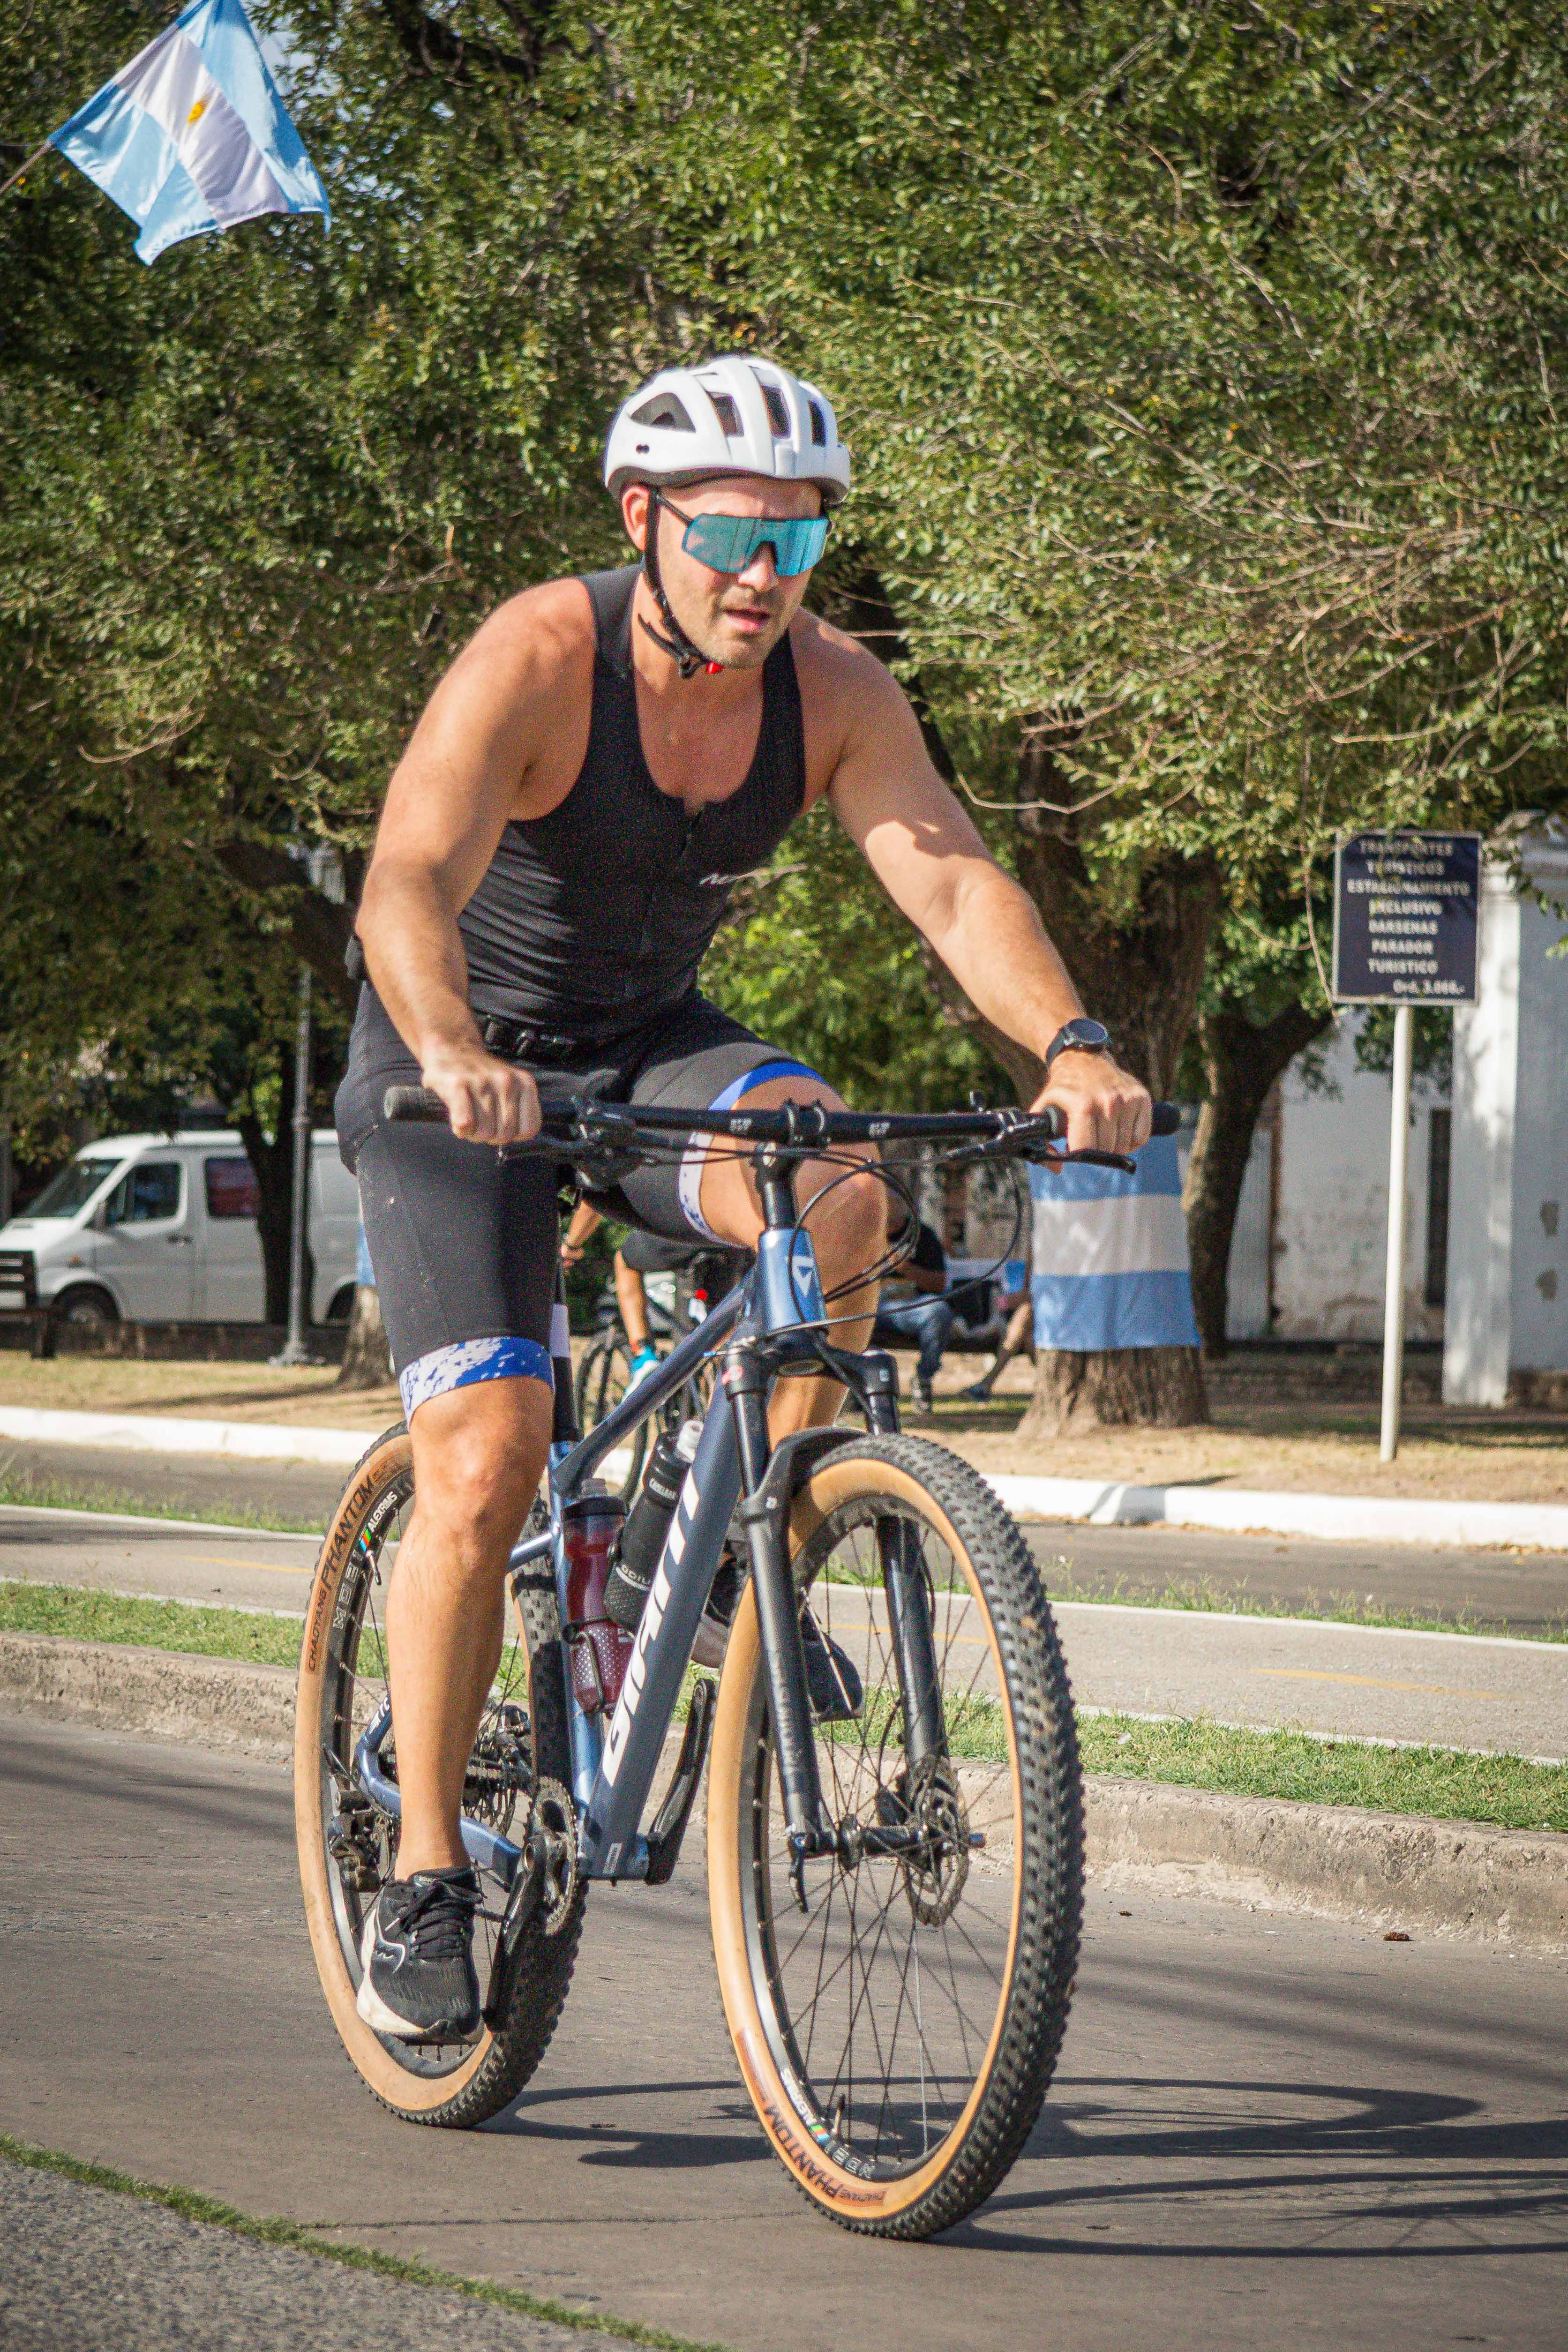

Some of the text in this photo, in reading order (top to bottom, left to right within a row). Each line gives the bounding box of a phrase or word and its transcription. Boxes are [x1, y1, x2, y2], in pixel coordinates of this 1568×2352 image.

[1346, 878, 1470, 896] ESTACIONAMIENTO
[1368, 899, 1443, 915] EXCLUSIVO
[1368, 919, 1439, 935] DARSENAS
[1371, 939, 1434, 954] PARADOR
[1367, 958, 1439, 974] TURISTICO
[367, 1491, 398, 1533] ALEXRIMS
[321, 1473, 376, 1590] PHANTOM
[763, 2103, 844, 2199] PHANTOM
